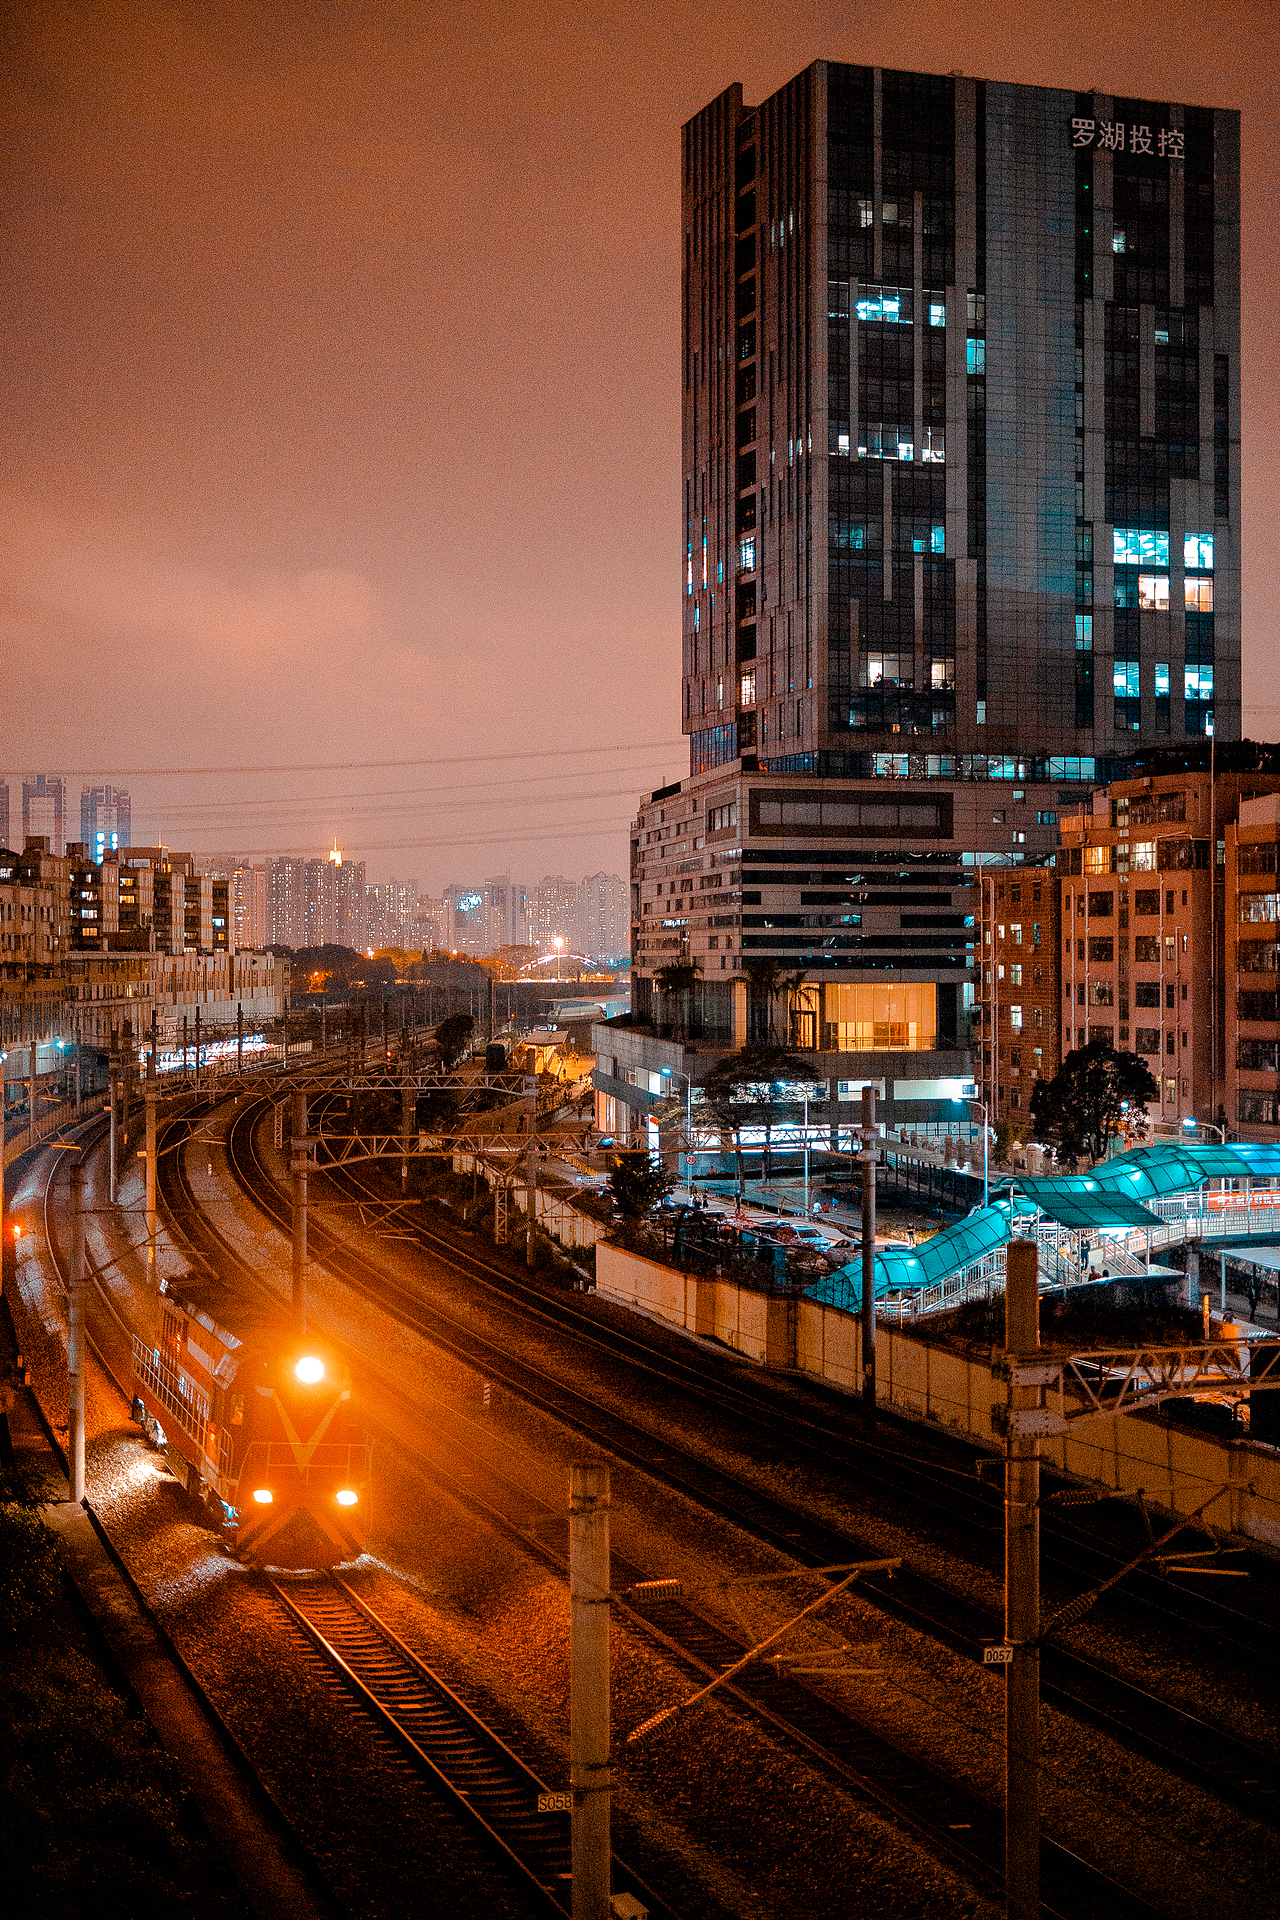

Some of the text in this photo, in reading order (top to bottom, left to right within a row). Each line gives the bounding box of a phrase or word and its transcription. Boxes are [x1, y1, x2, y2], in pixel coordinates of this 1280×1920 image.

[1072, 118, 1185, 159] 罗湖投控
[538, 1795, 572, 1811] S058
